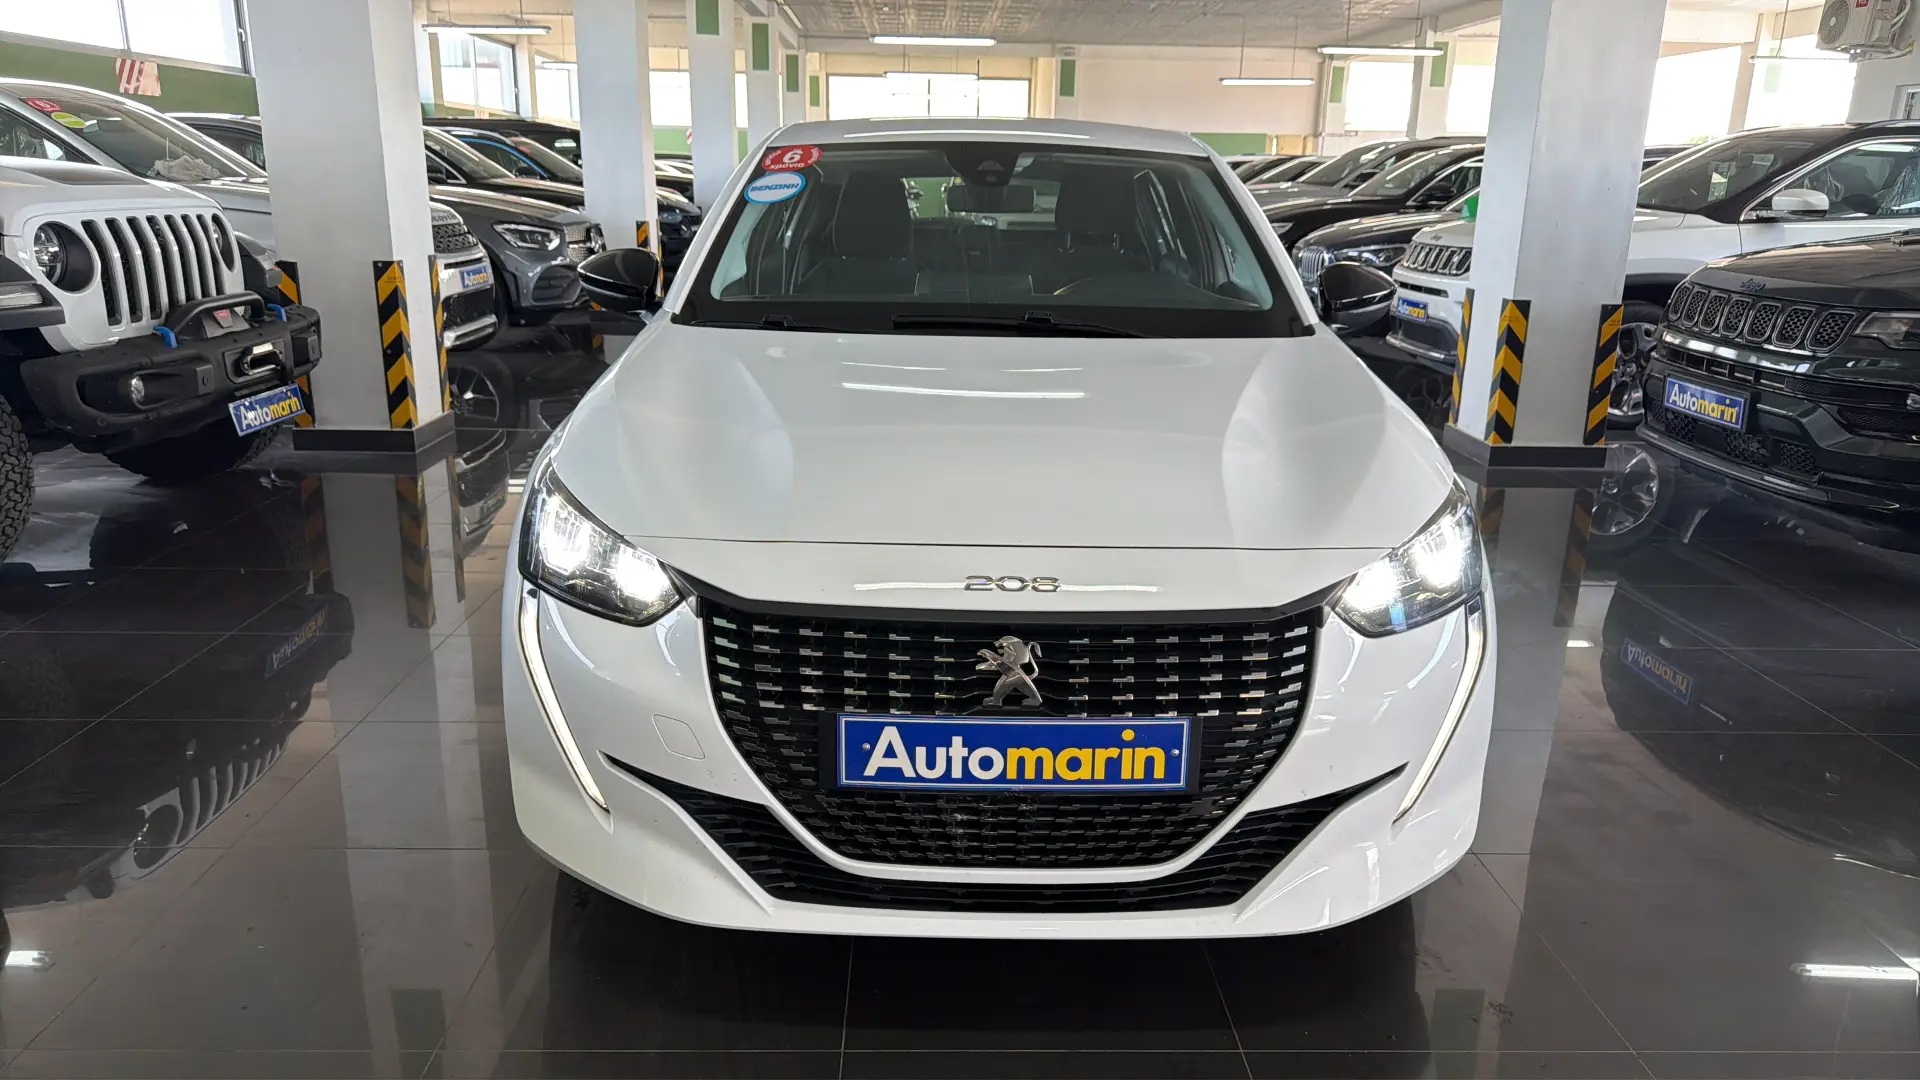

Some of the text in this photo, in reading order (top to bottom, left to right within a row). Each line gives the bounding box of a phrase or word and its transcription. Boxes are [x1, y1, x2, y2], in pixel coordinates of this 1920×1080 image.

[783, 149, 803, 163] 6
[239, 391, 301, 430] Automarin
[1669, 384, 1737, 423] Automarin
[963, 575, 1060, 592] 208
[863, 725, 1166, 781] Automarin
